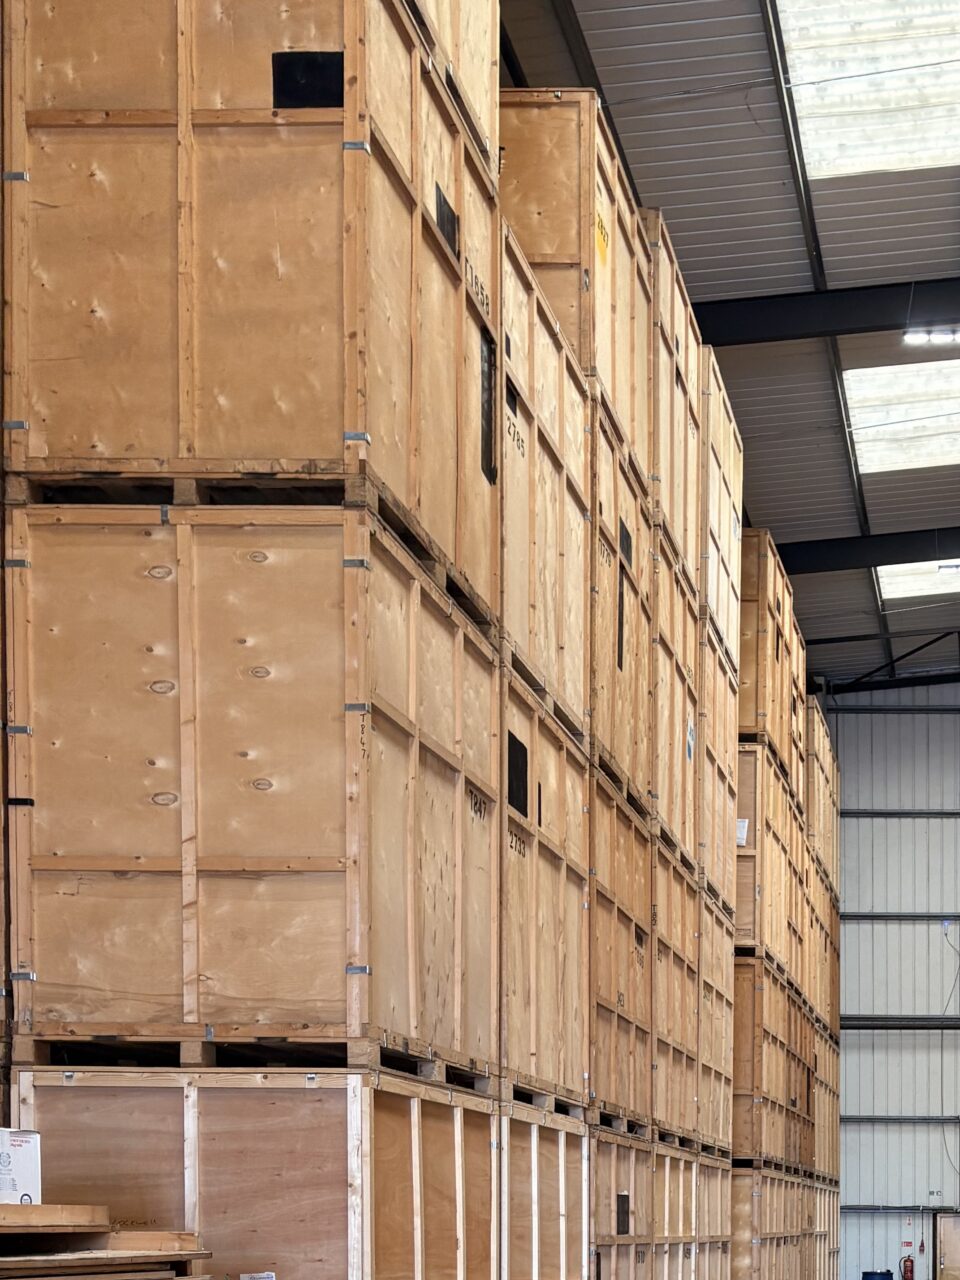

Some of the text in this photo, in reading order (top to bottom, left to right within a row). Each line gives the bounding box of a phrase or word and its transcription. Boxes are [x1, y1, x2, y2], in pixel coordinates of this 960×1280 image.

[506, 413, 524, 458] 2785
[469, 788, 487, 821] T847
[508, 829, 525, 858] 2733
